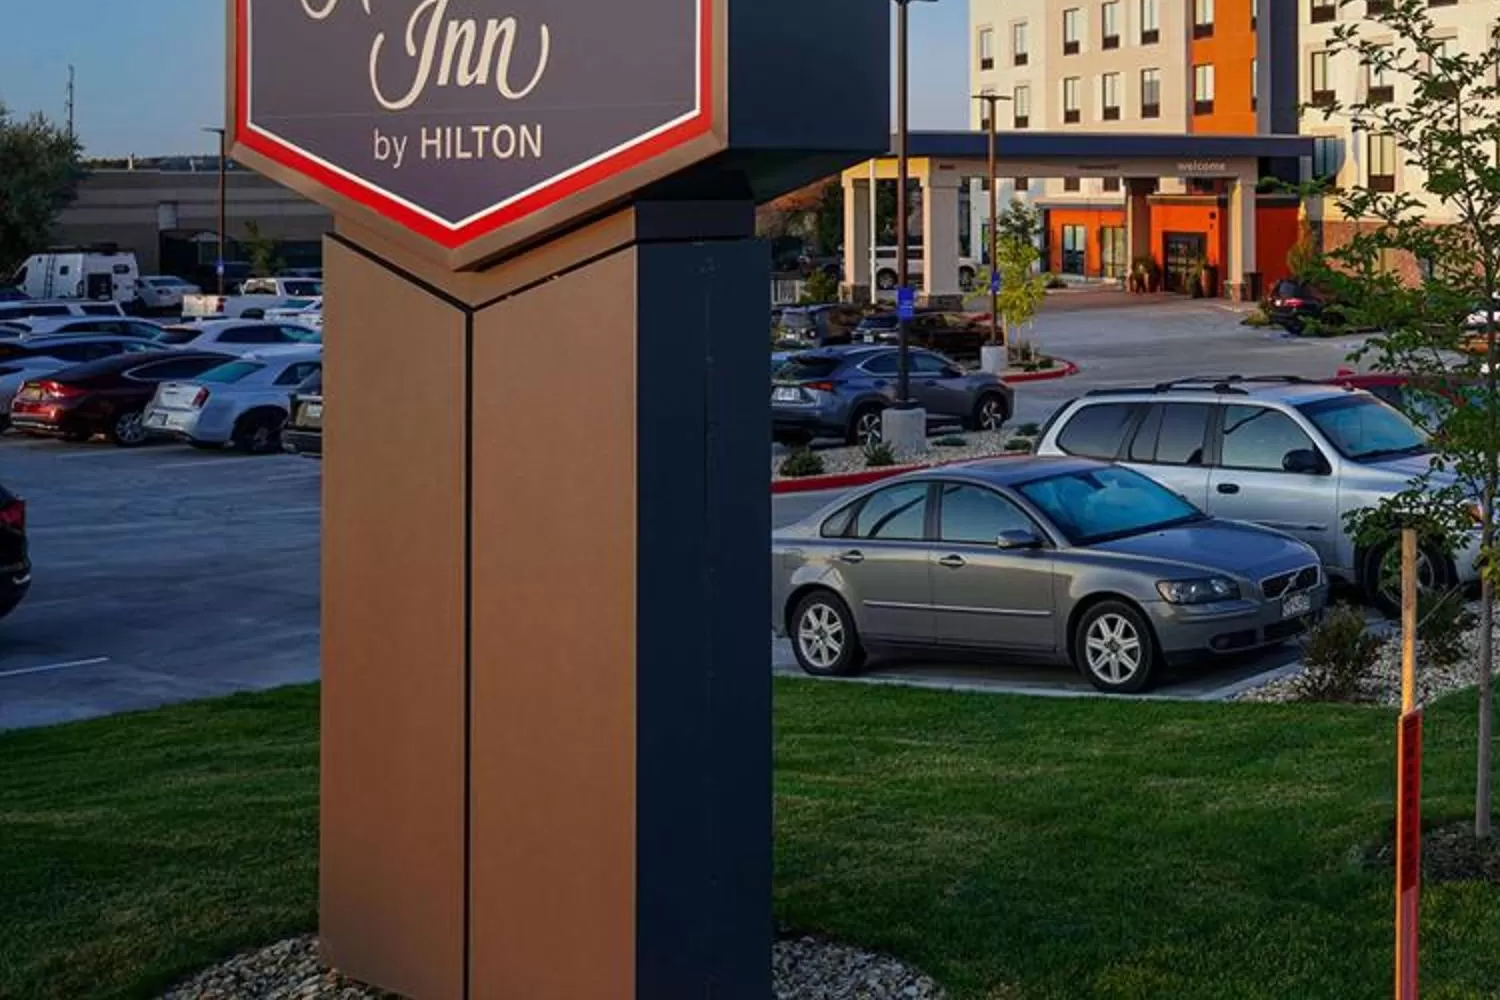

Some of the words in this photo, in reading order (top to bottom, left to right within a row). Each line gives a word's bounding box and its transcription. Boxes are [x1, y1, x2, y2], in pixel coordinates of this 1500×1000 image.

[373, 127, 408, 169] by
[420, 123, 542, 160] HILTON
[1176, 160, 1226, 171] welcome
